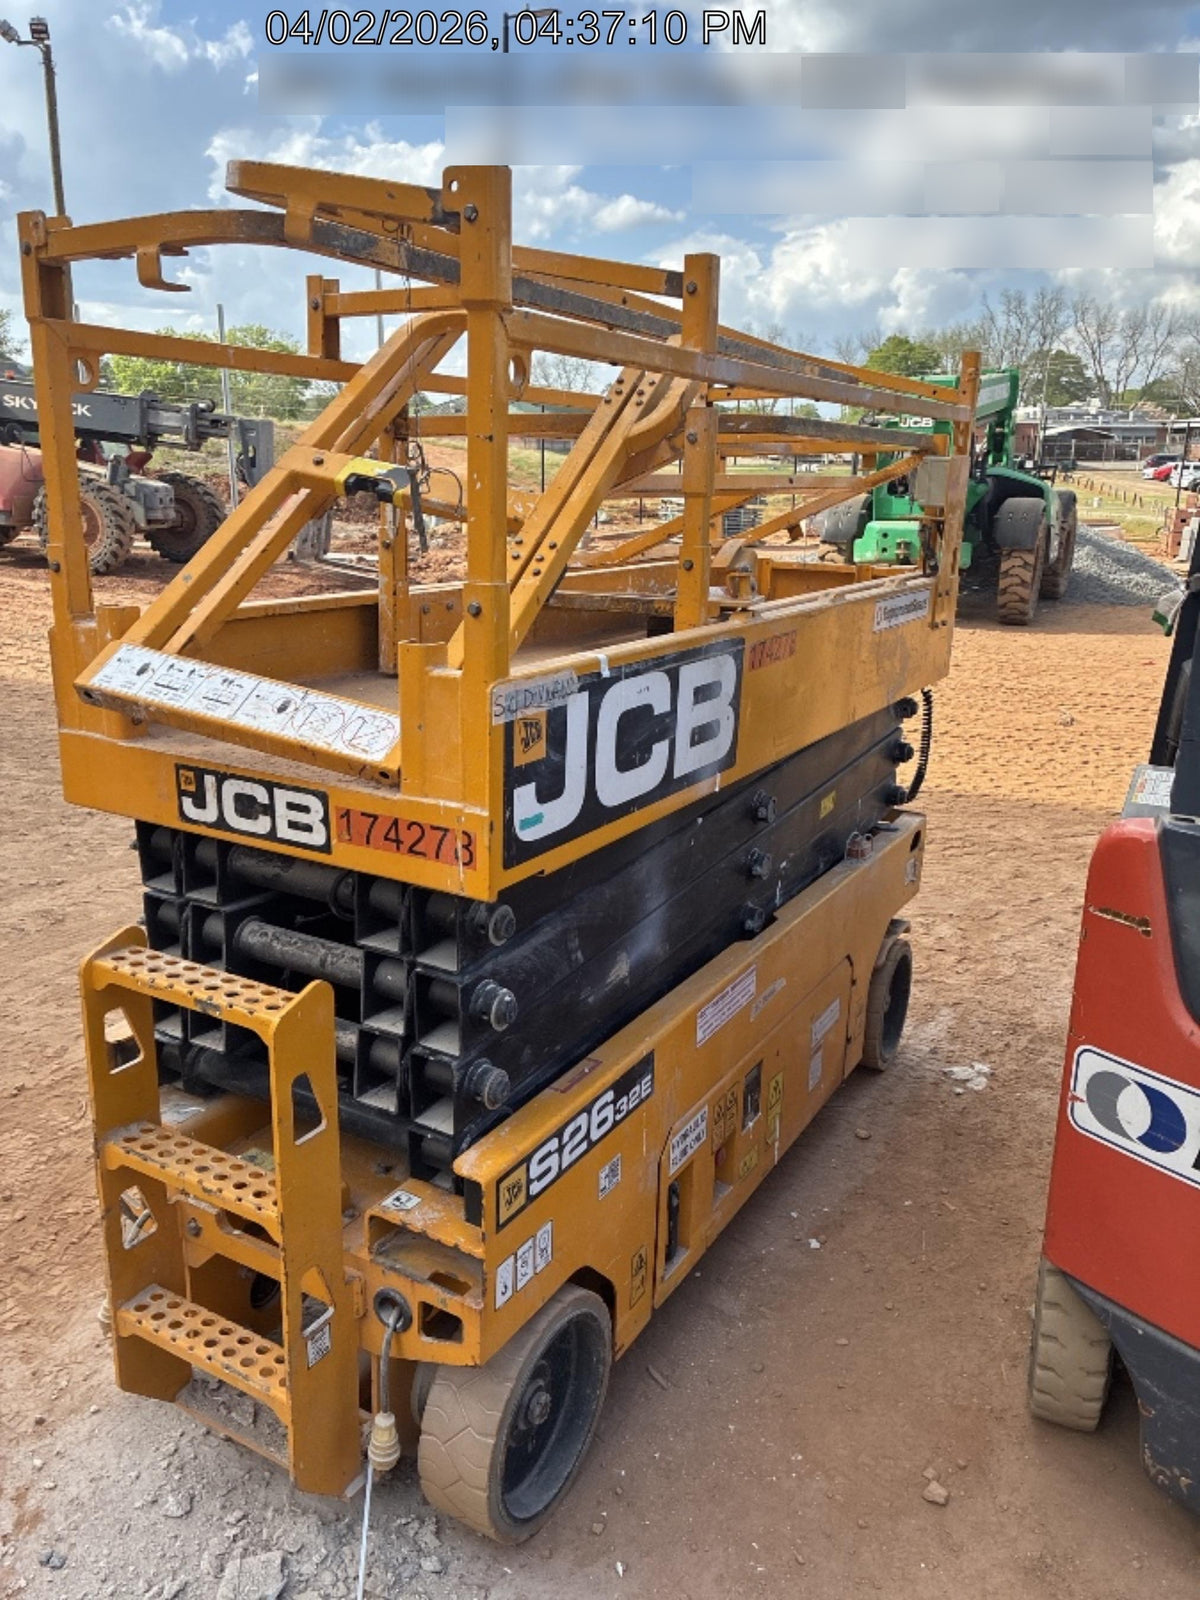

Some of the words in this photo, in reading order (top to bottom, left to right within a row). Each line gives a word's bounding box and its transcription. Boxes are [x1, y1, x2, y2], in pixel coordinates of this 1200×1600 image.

[899, 414, 934, 428] JCB
[513, 654, 738, 842] JCB
[181, 774, 327, 847] JCB
[339, 808, 474, 867] 174278
